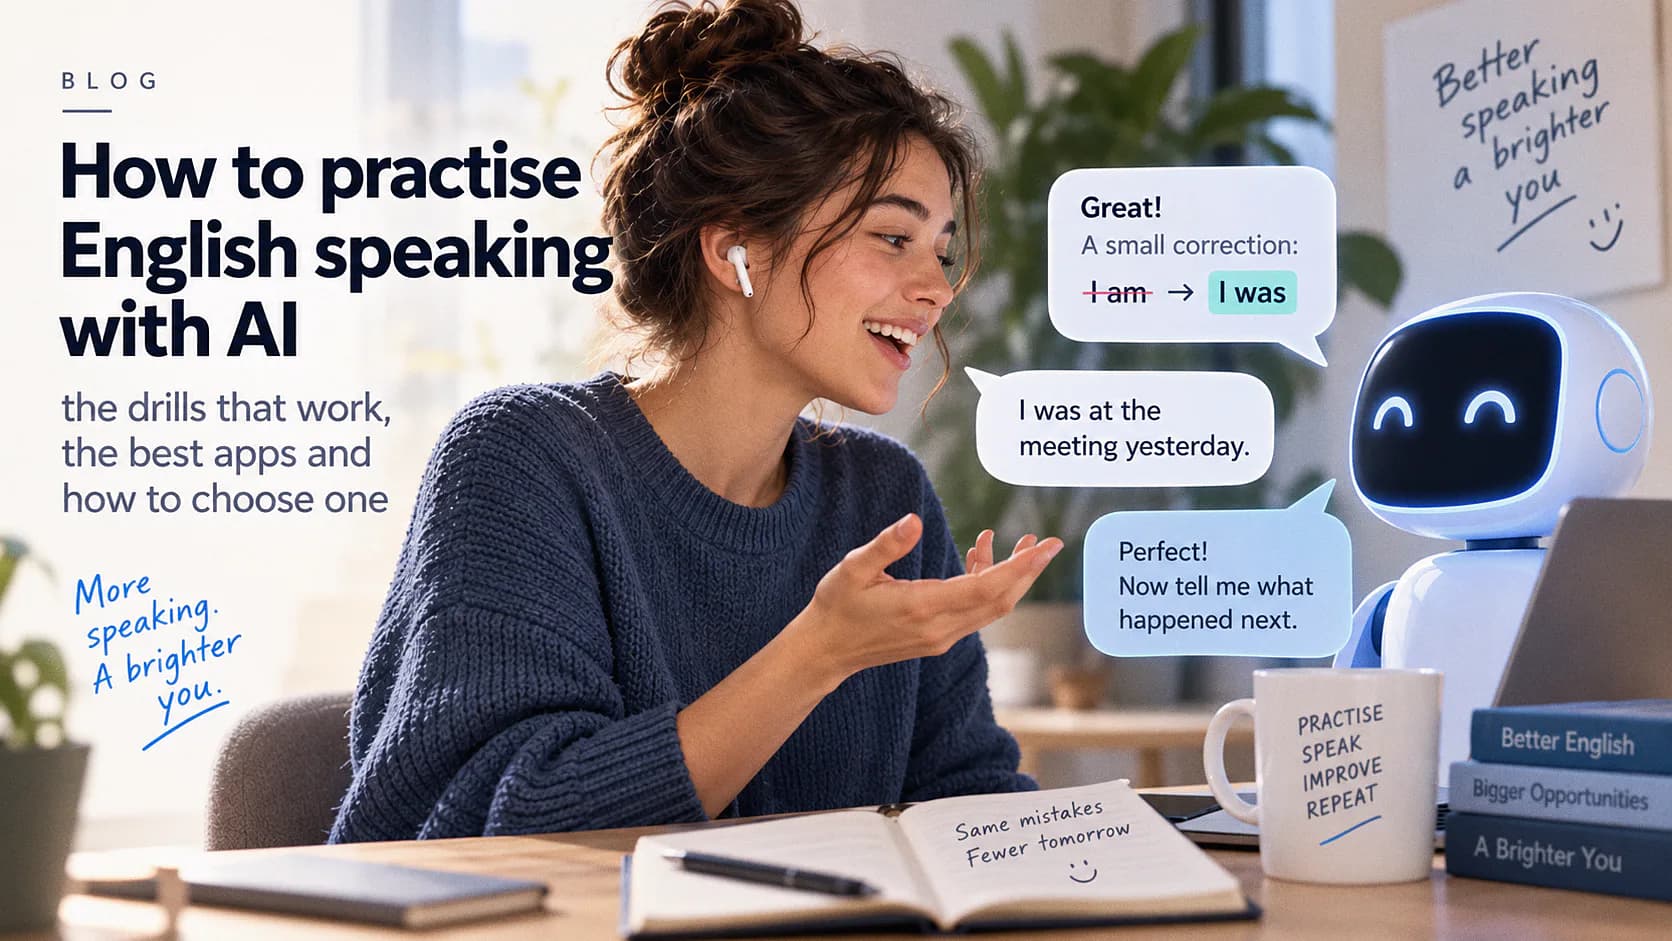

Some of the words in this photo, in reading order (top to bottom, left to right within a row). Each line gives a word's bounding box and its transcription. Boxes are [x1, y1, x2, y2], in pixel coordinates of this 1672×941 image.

[1433, 39, 1540, 108] Better
[1461, 58, 1599, 144] speaking
[1454, 166, 1472, 189] a
[1493, 101, 1610, 169] brighter
[1505, 169, 1561, 224] you
[1298, 704, 1384, 736] PRACTISE
[1302, 734, 1362, 764] SPEAK
[1501, 727, 1557, 752] Better
[1565, 730, 1635, 760] English
[1303, 756, 1383, 792] IMPROVE
[1307, 783, 1379, 820] REPEAT
[1473, 778, 1525, 803] Bigger
[1530, 782, 1649, 811] Opportunities
[955, 821, 1010, 841] Same
[1020, 801, 1103, 828] mistakes
[966, 844, 1028, 868] Fewer
[1038, 823, 1130, 851] tomorrow
[1474, 836, 1489, 858] A
[1496, 837, 1574, 870] Brighter
[1581, 847, 1623, 874] You
